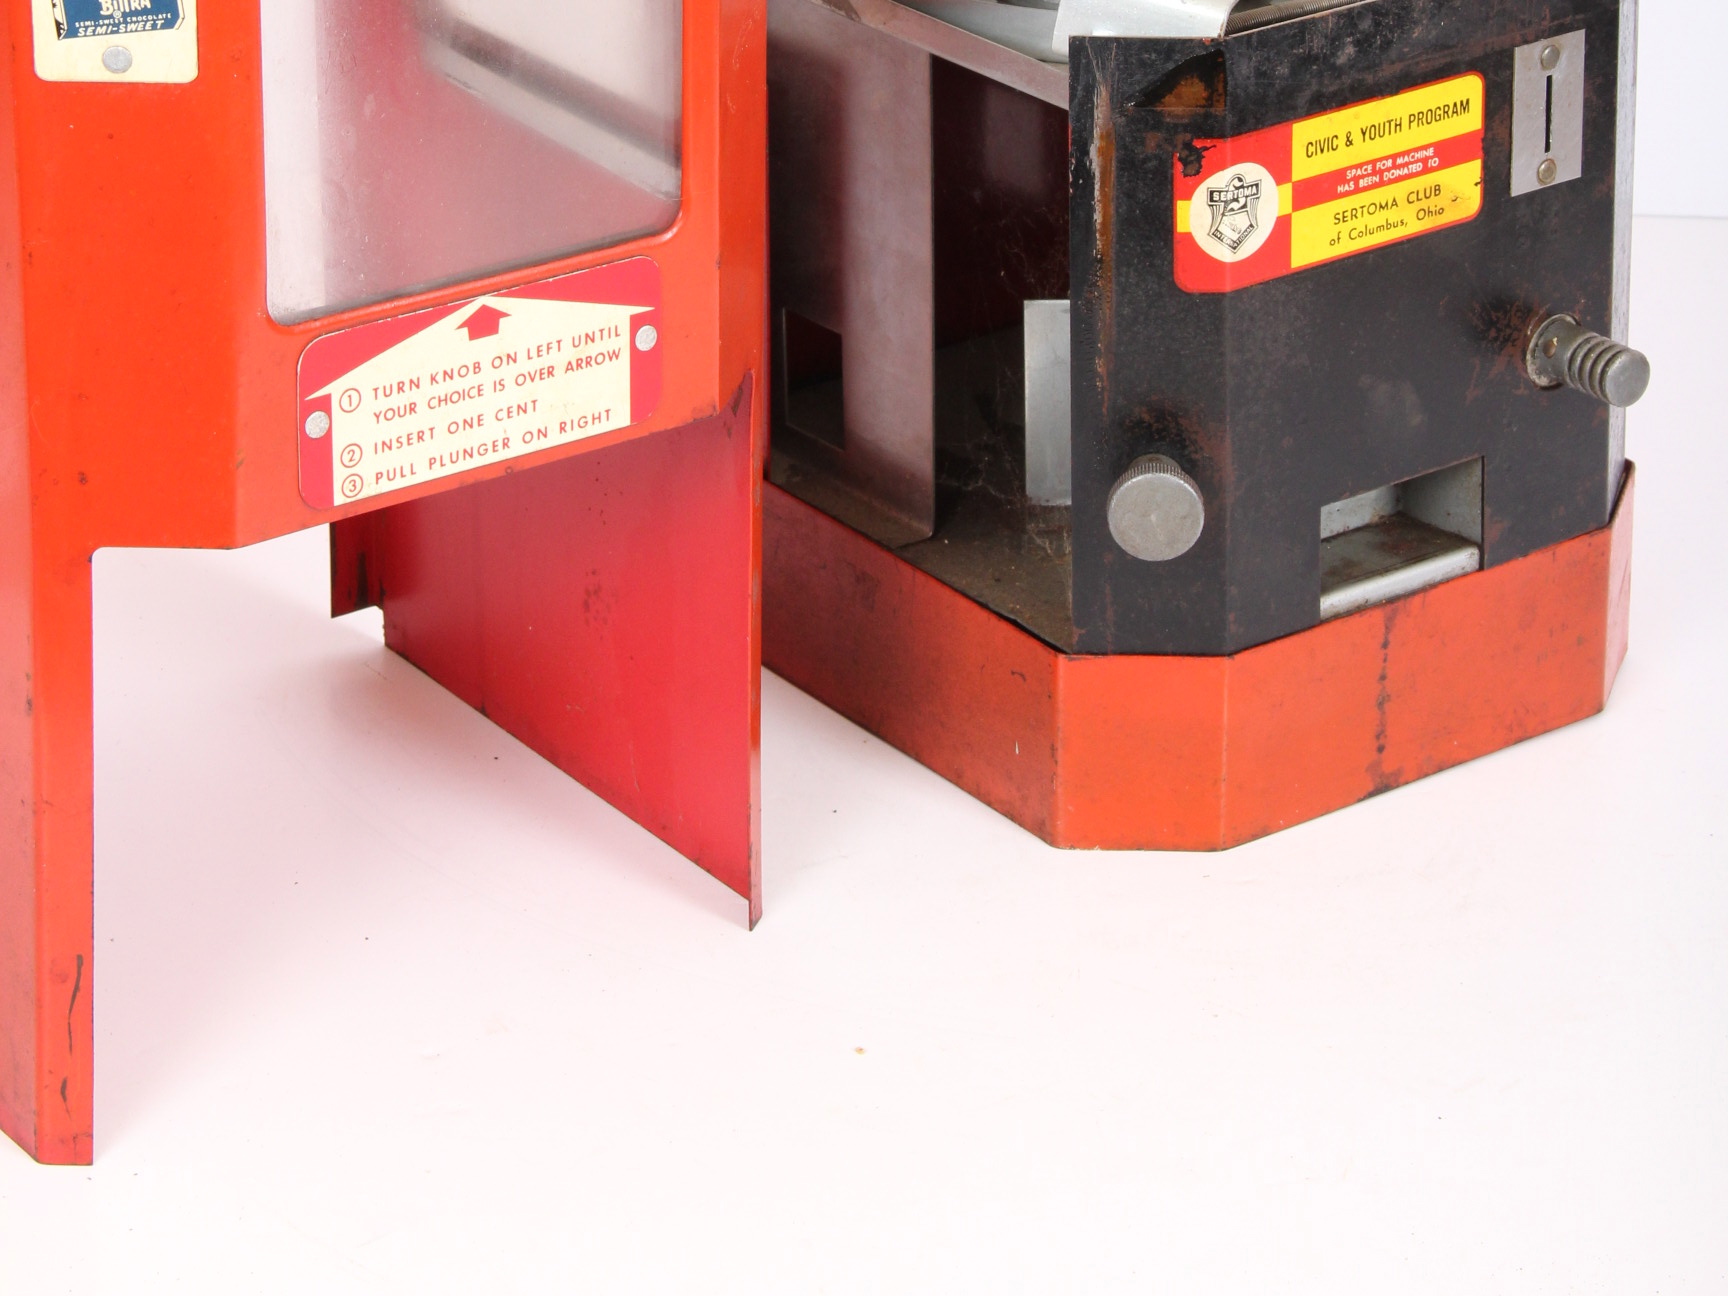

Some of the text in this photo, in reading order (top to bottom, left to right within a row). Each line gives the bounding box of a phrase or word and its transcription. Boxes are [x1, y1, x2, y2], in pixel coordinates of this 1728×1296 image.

[75, 12, 172, 28] SEMI-SWEET CHOCOLATE
[77, 20, 165, 37] SEMI-SWEET
[1305, 98, 1471, 159] CIVIC & YOUTH PROGRAM
[1337, 181, 1355, 194] HAS
[1358, 173, 1381, 188] BEEN
[1383, 162, 1423, 181] DONATED
[1346, 147, 1435, 179] SPACE FOR MACHINE
[1213, 185, 1257, 201] SERTOMA
[1333, 184, 1442, 226] SERTOMA CLUB
[1329, 205, 1445, 247] of Columbus, Ohio
[373, 377, 421, 401] TURN
[430, 361, 482, 386] KNOB
[491, 351, 518, 369] ON
[526, 339, 563, 360] LEFT
[571, 325, 622, 349] UNTIL
[372, 348, 622, 425] YOUR CHOICE IS OVER ARROW
[373, 427, 435, 455] INSERT
[447, 414, 485, 435] ONE
[494, 399, 539, 423] CENT
[375, 463, 417, 485] PULL
[429, 437, 511, 471] PLUNGER
[522, 427, 548, 445] ON
[559, 409, 612, 434] RIGHT
